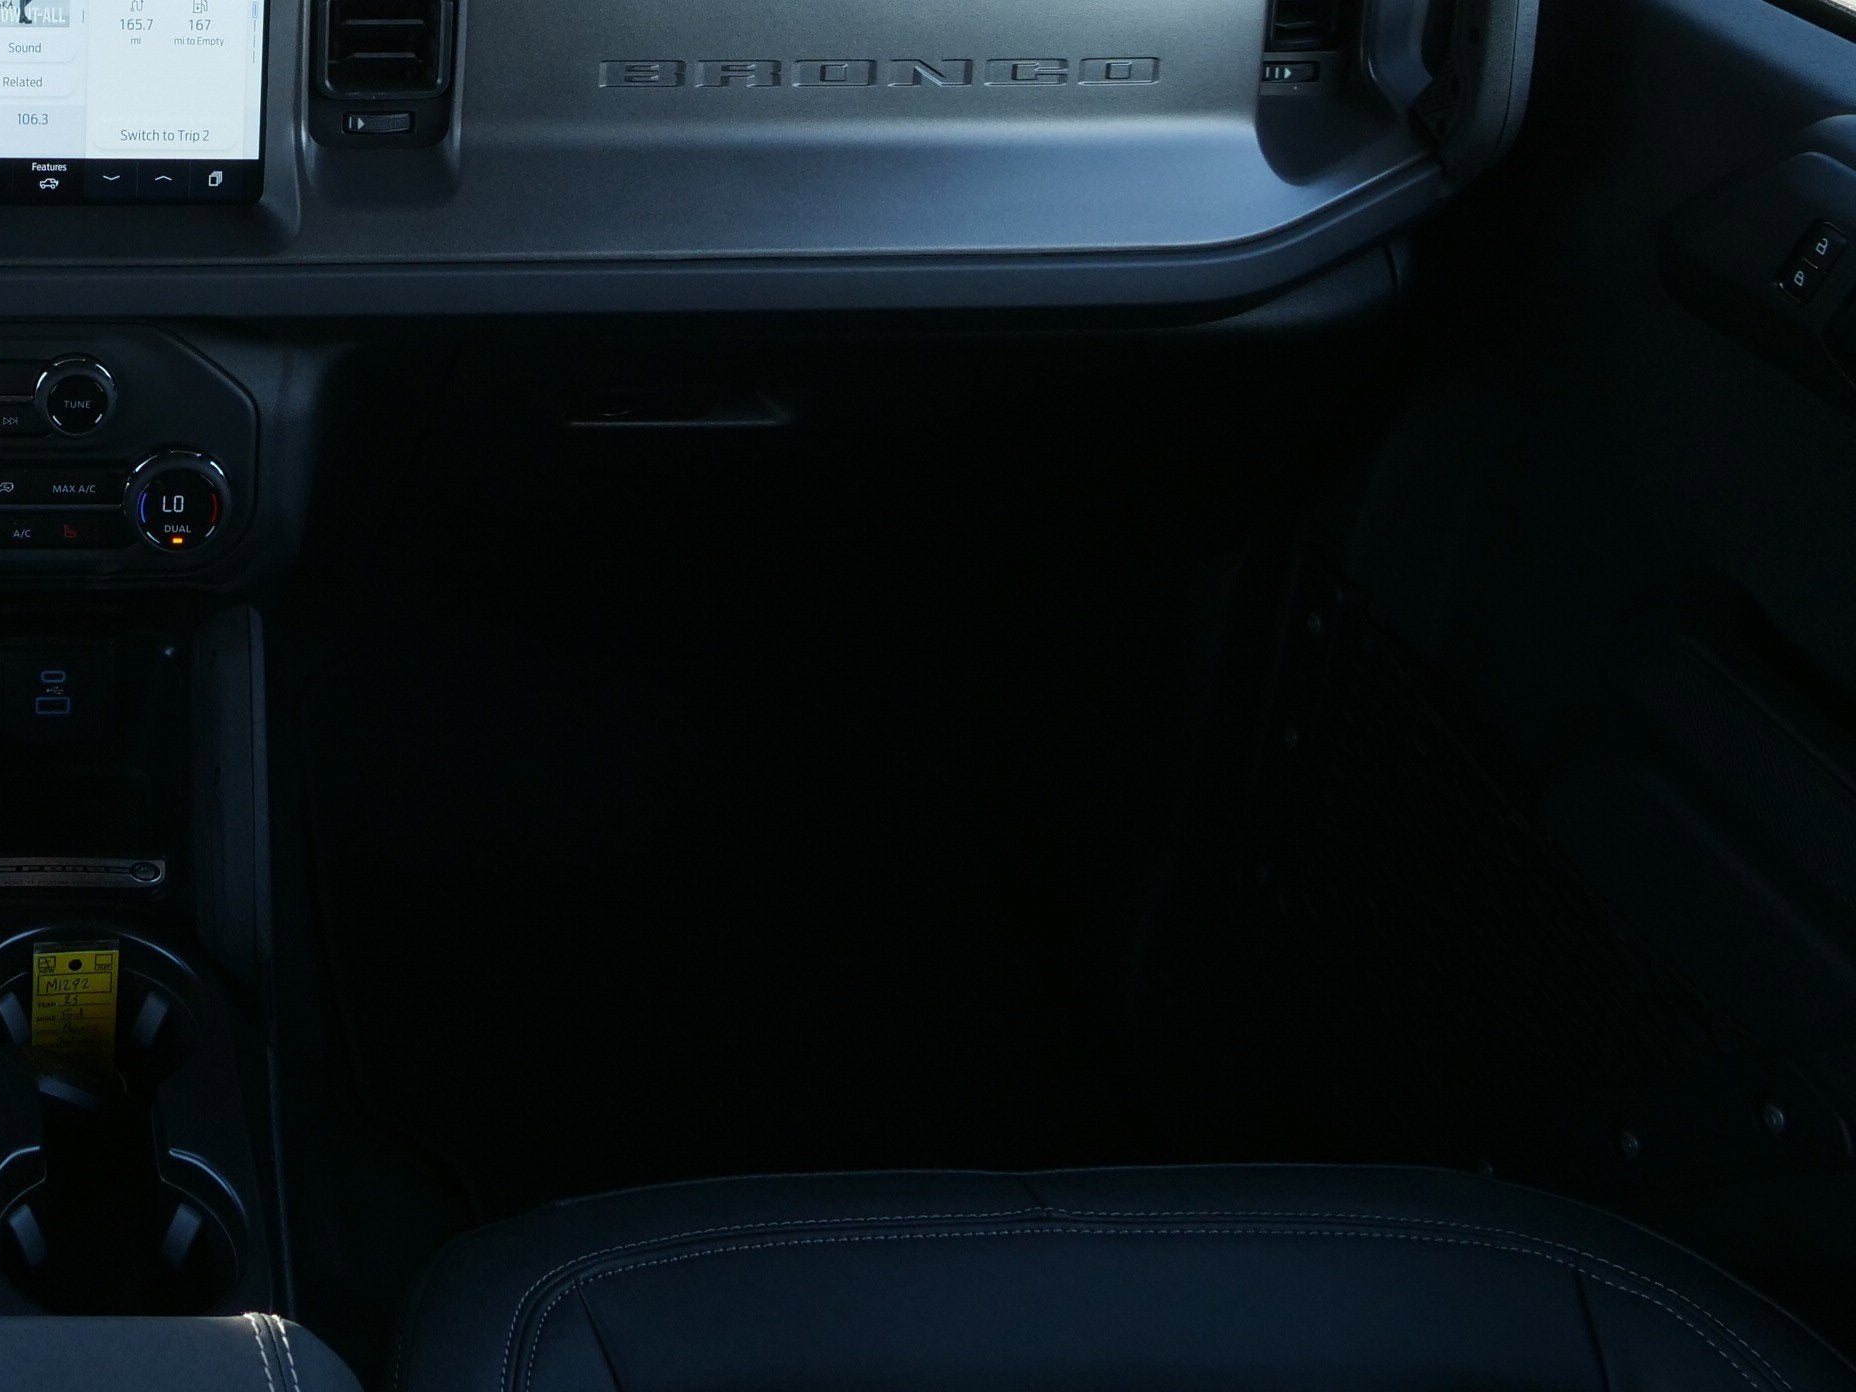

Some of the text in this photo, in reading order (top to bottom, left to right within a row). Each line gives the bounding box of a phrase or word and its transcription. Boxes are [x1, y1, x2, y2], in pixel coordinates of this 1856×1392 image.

[120, 19, 153, 31] 165.7
[188, 19, 211, 31] 167
[130, 36, 141, 45] mi
[174, 36, 225, 48] mi to Empty
[8, 43, 42, 54] Sound
[598, 56, 1162, 88] BRONCO
[2, 77, 43, 88] Related
[17, 113, 49, 125] 106.3
[120, 130, 210, 145] Switch to Trip 2
[31, 162, 67, 172] Features
[64, 400, 91, 409] TUNE
[52, 484, 97, 494] MAX A/C
[13, 528, 32, 538] A/C
[164, 524, 191, 533] DUAL
[45, 978, 91, 993] M1292
